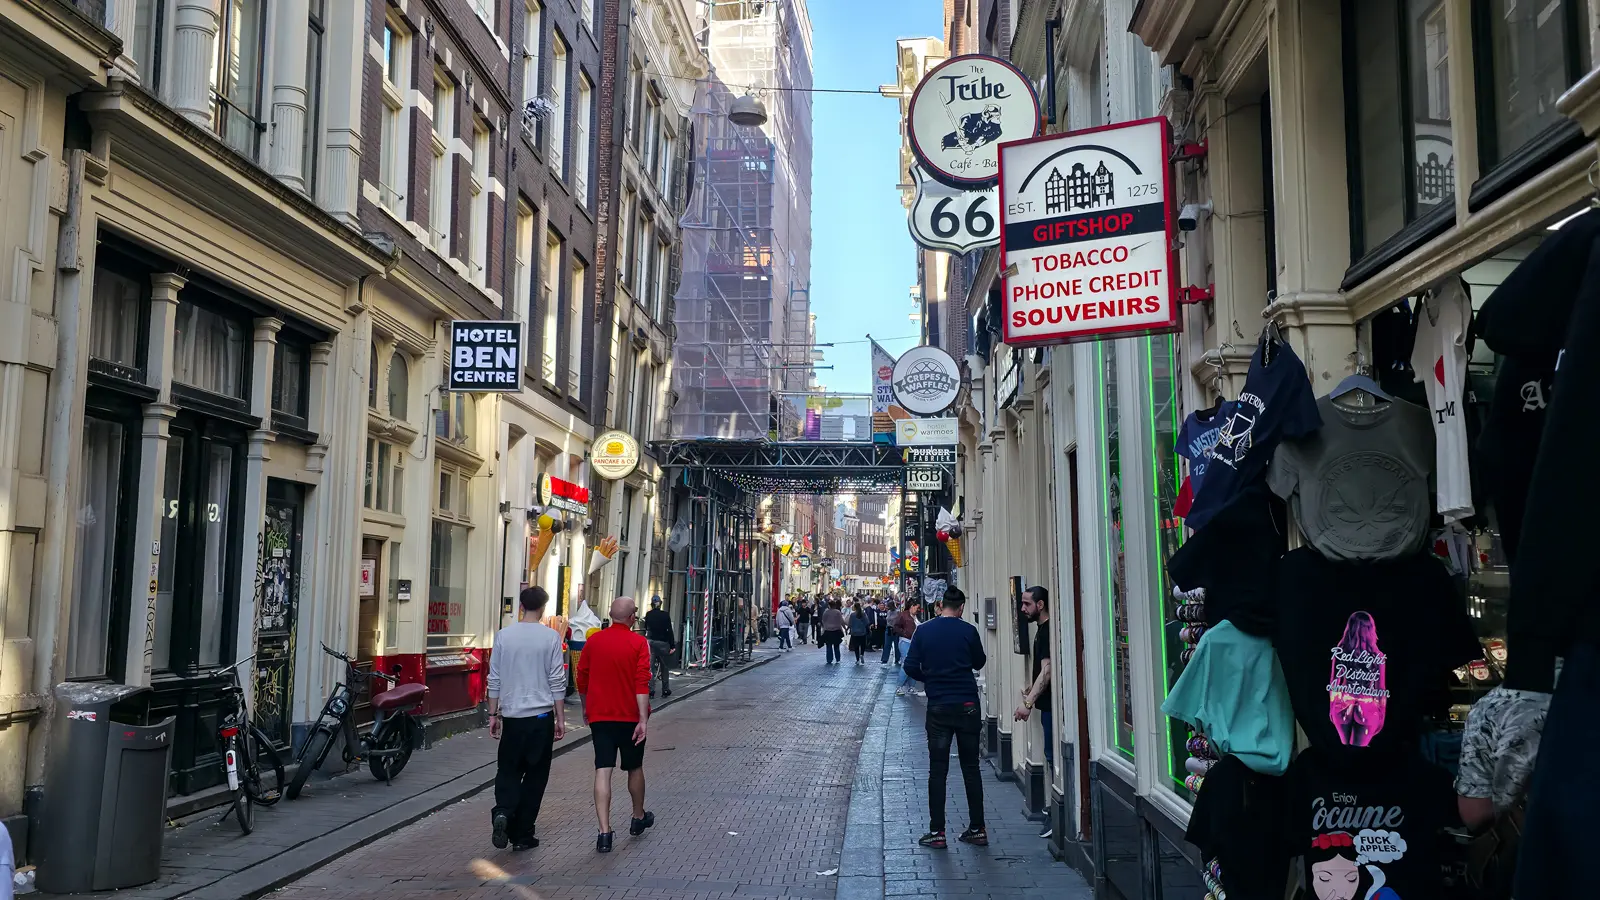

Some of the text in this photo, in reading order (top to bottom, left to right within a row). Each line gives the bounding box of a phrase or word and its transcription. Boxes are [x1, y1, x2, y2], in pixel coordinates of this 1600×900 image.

[969, 65, 984, 74] The
[937, 75, 1012, 106] Tribe
[949, 159, 972, 174] Café
[982, 158, 998, 168] Ba
[1008, 183, 1159, 216] EST. 1275
[930, 196, 995, 238] 66
[1033, 212, 1134, 242] GIFTSHOP
[1031, 245, 1129, 273] TOBACCO
[1012, 268, 1163, 303] PHONE CREDIT
[1012, 295, 1161, 328] SOUVENIRS
[456, 328, 517, 343] HOTEL
[454, 346, 517, 369] BEN
[453, 370, 516, 383] CENTRE
[906, 373, 941, 383] CREPES
[905, 381, 949, 392] WAFFLES
[913, 448, 951, 456] BURGER
[428, 601, 462, 617] HOTEL BEN
[1330, 646, 1388, 669] Red Light
[1335, 663, 1381, 682] District
[1325, 678, 1391, 698] Amsterdam
[1332, 792, 1358, 805] Enjoy
[1359, 845, 1401, 853] APPLES.
[1360, 836, 1392, 845] FUCK
